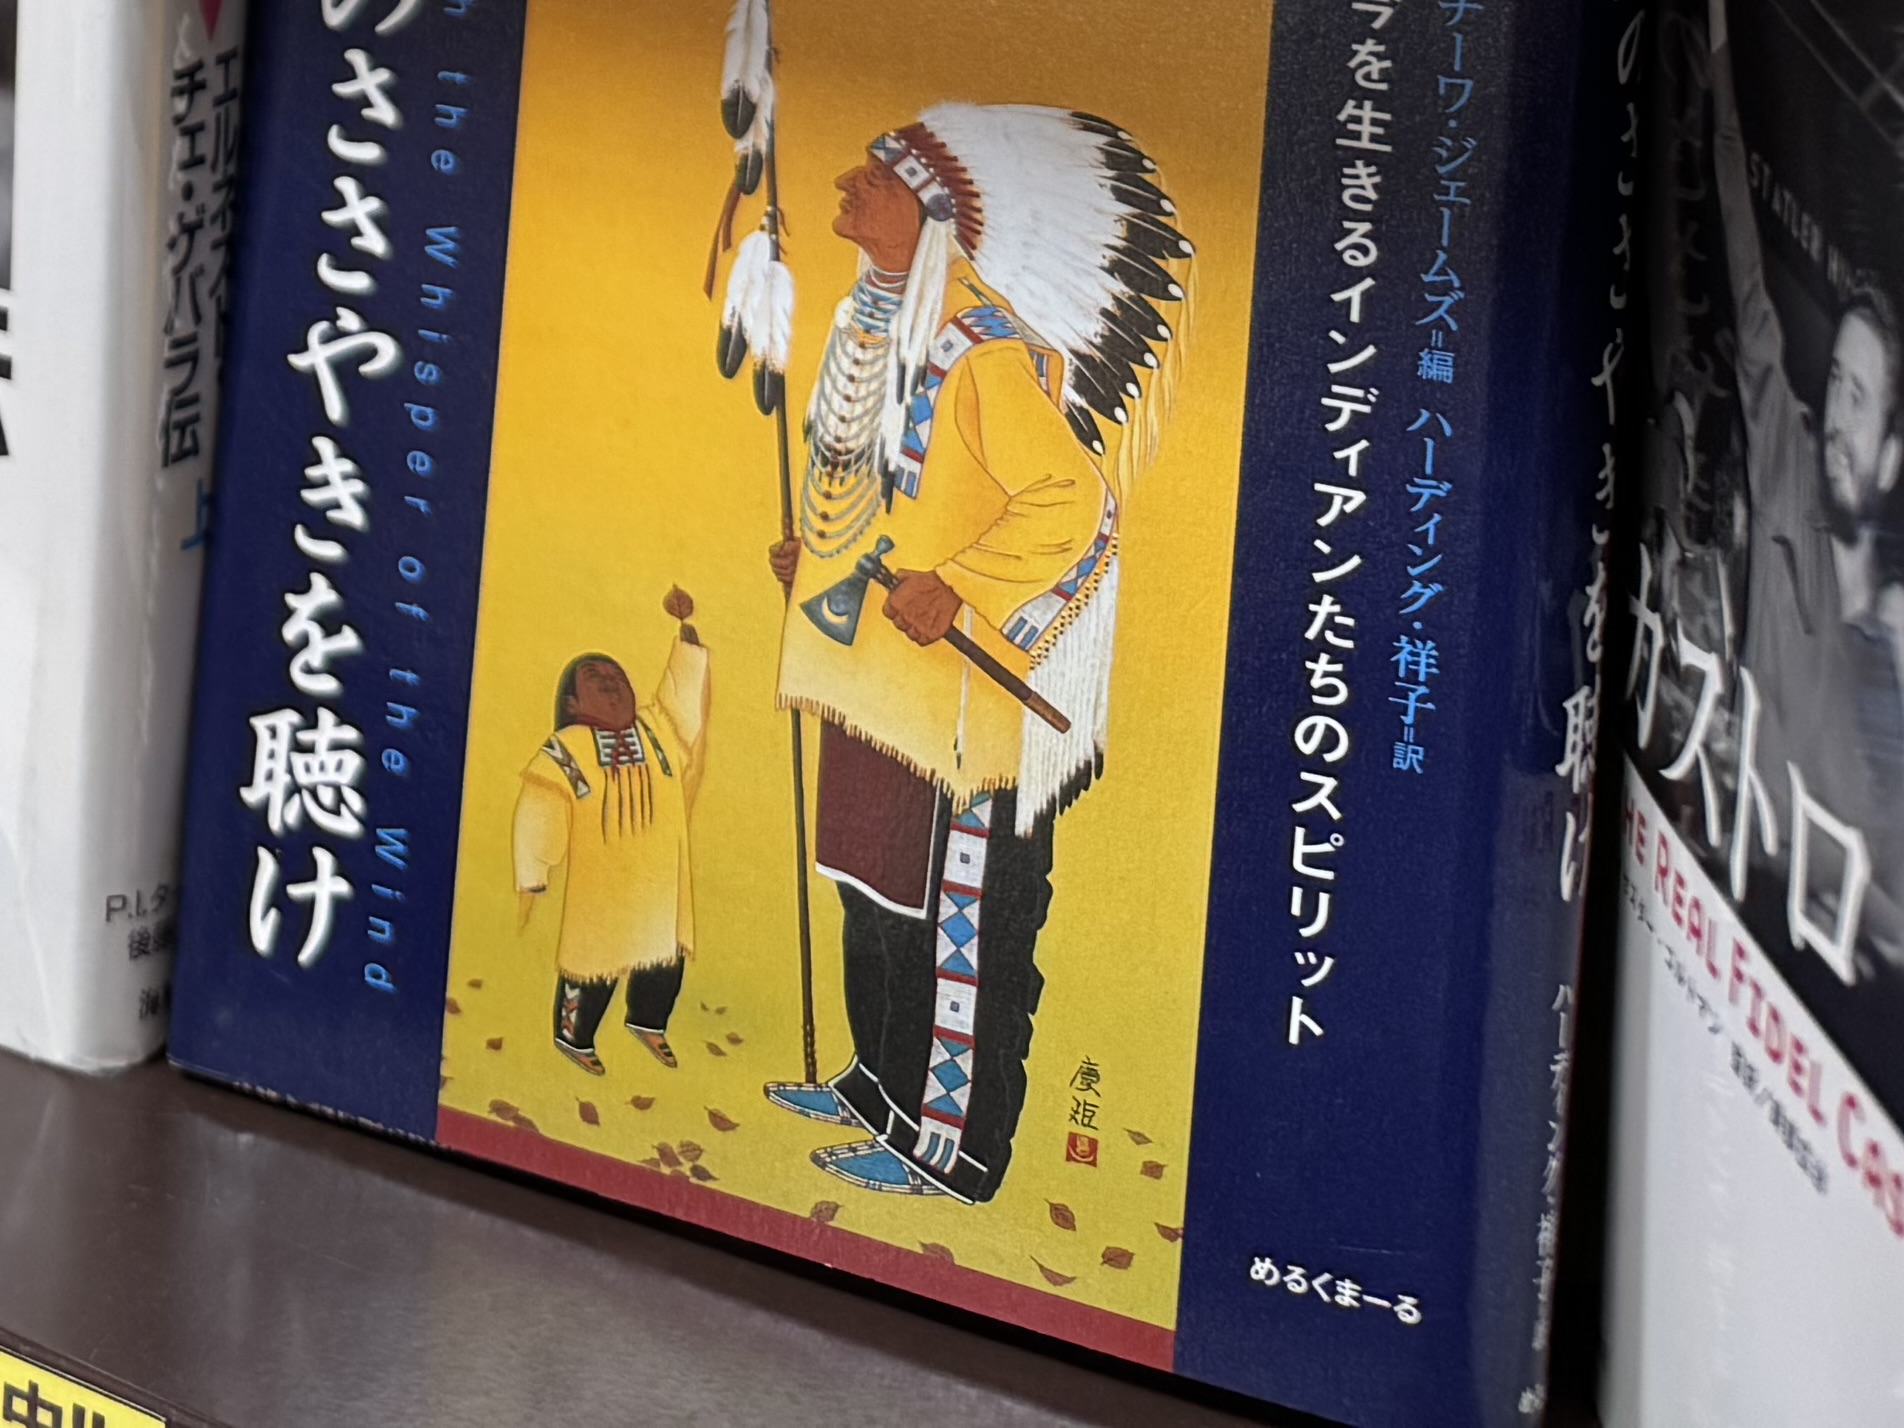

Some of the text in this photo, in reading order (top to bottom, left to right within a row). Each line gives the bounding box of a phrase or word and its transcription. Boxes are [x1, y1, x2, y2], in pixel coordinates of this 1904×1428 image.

[429, 66, 471, 175] the
[400, 222, 463, 516] Whisper
[392, 553, 433, 624] of
[379, 665, 423, 779] the
[1626, 543, 1872, 986] カストロ
[361, 823, 413, 993] Wind
[1622, 796, 1650, 872] HE
[1654, 819, 1725, 983] REAL
[1728, 935, 1828, 1129] FIDEL
[1247, 1253, 1423, 1325] めるくまーる
